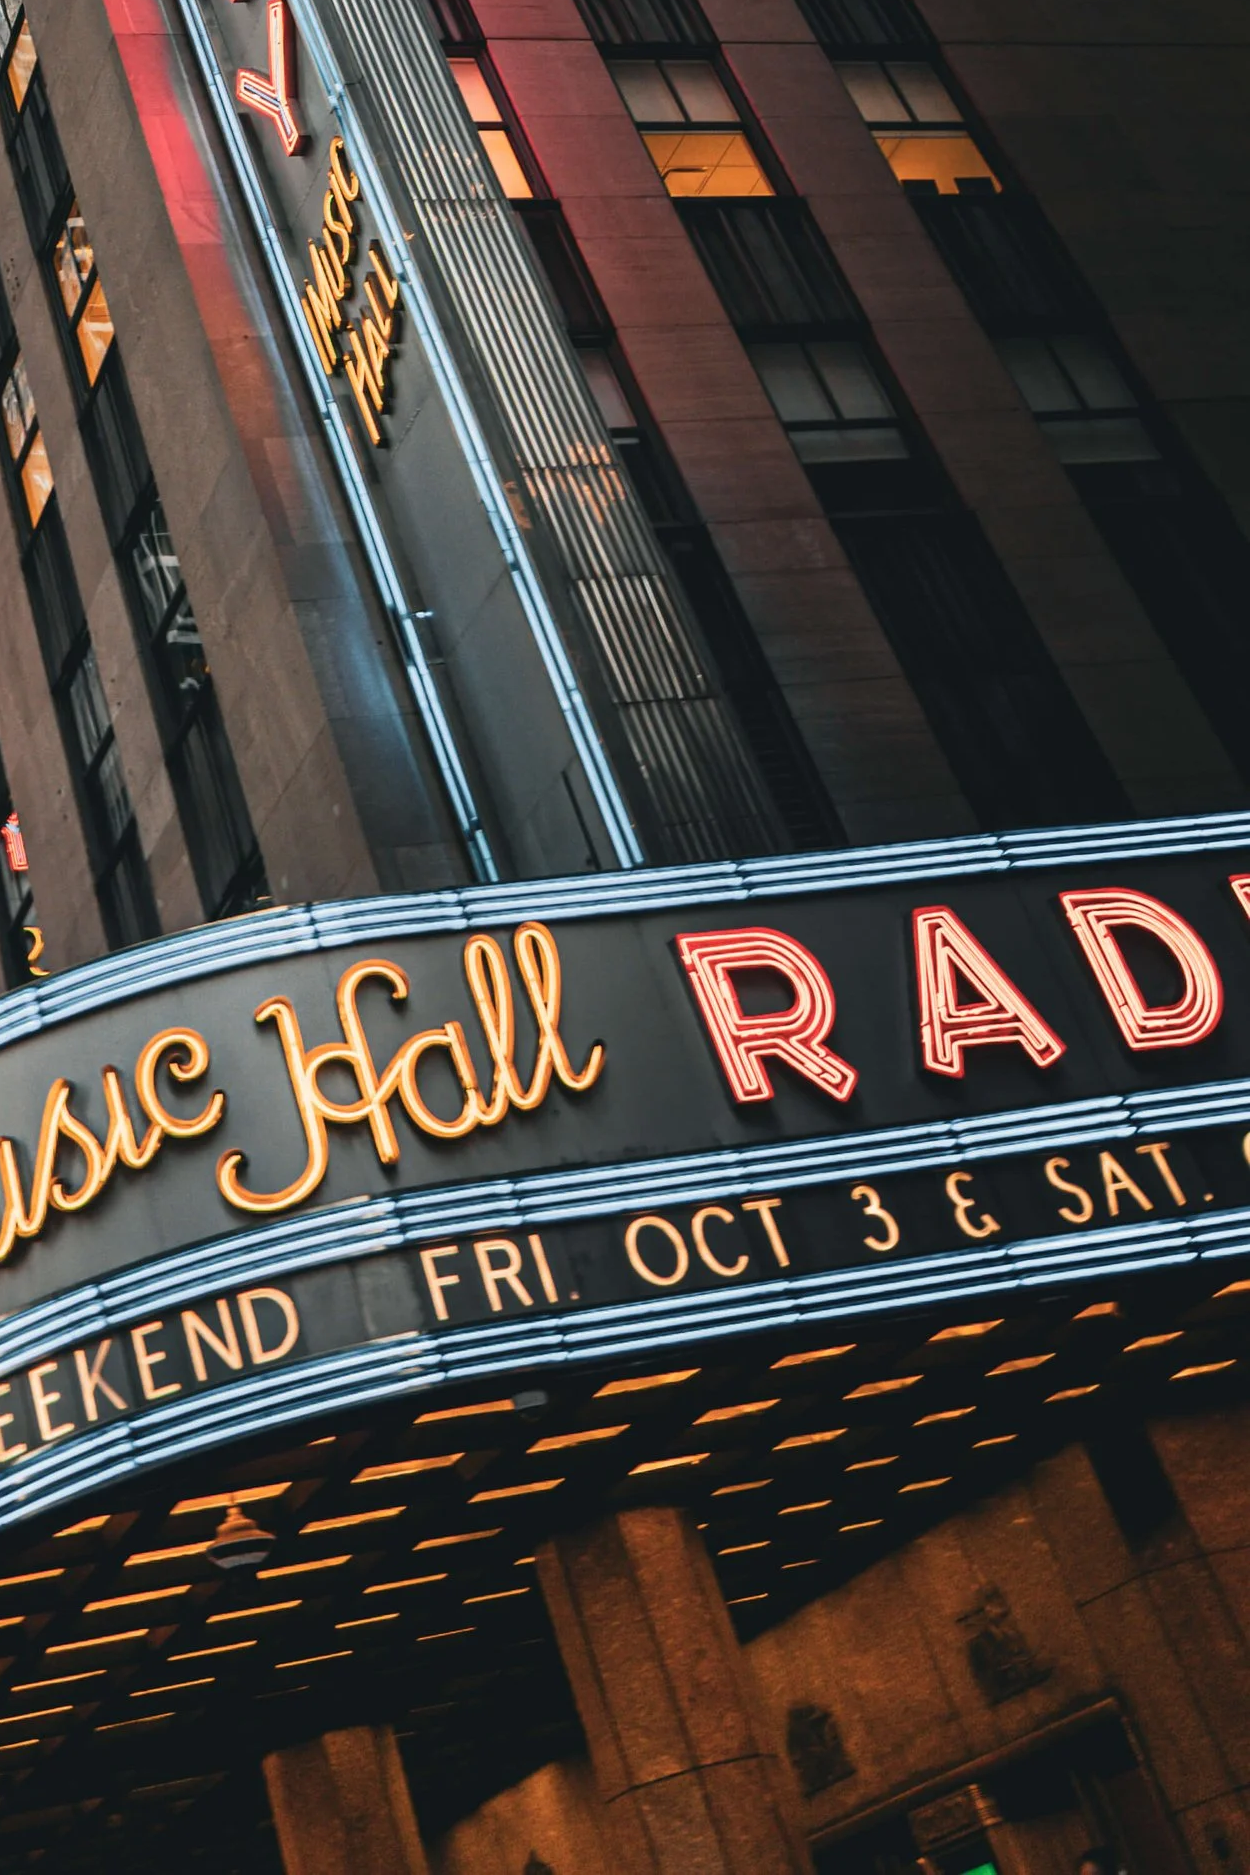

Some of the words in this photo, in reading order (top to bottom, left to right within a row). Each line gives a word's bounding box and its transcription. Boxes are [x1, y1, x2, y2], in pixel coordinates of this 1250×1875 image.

[301, 135, 360, 375] MUSIC
[345, 247, 398, 447] HALL
[215, 920, 607, 1213] Hall
[675, 874, 1250, 1103] RAD
[419, 1233, 581, 1322] FRI.
[623, 1196, 792, 1287] OCT
[851, 1184, 901, 1253] 3
[946, 1171, 1002, 1239] &
[1044, 1141, 1215, 1224] SAT.
